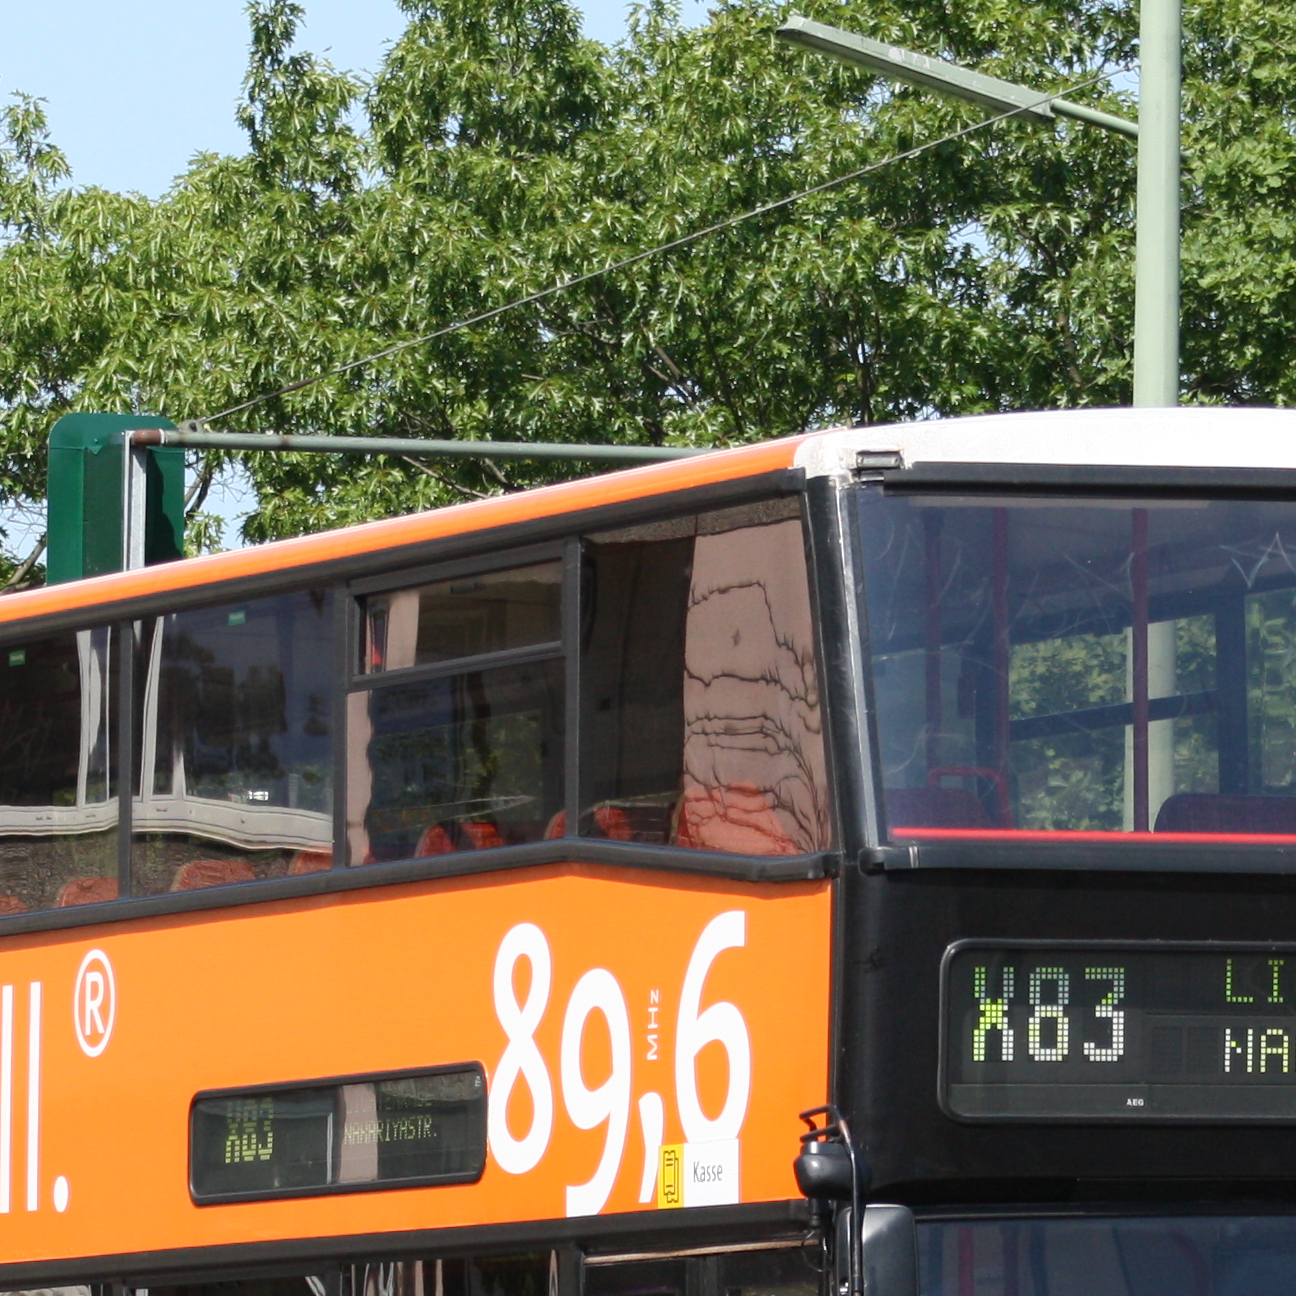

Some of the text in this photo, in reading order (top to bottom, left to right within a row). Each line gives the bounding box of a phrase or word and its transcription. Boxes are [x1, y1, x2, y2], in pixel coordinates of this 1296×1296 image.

[646, 988, 660, 1061] MHz
[972, 966, 1125, 1062] X83
[491, 909, 752, 1218] 89,6
[1126, 1098, 1144, 1107] AEG
[693, 1160, 723, 1183] Kasse
